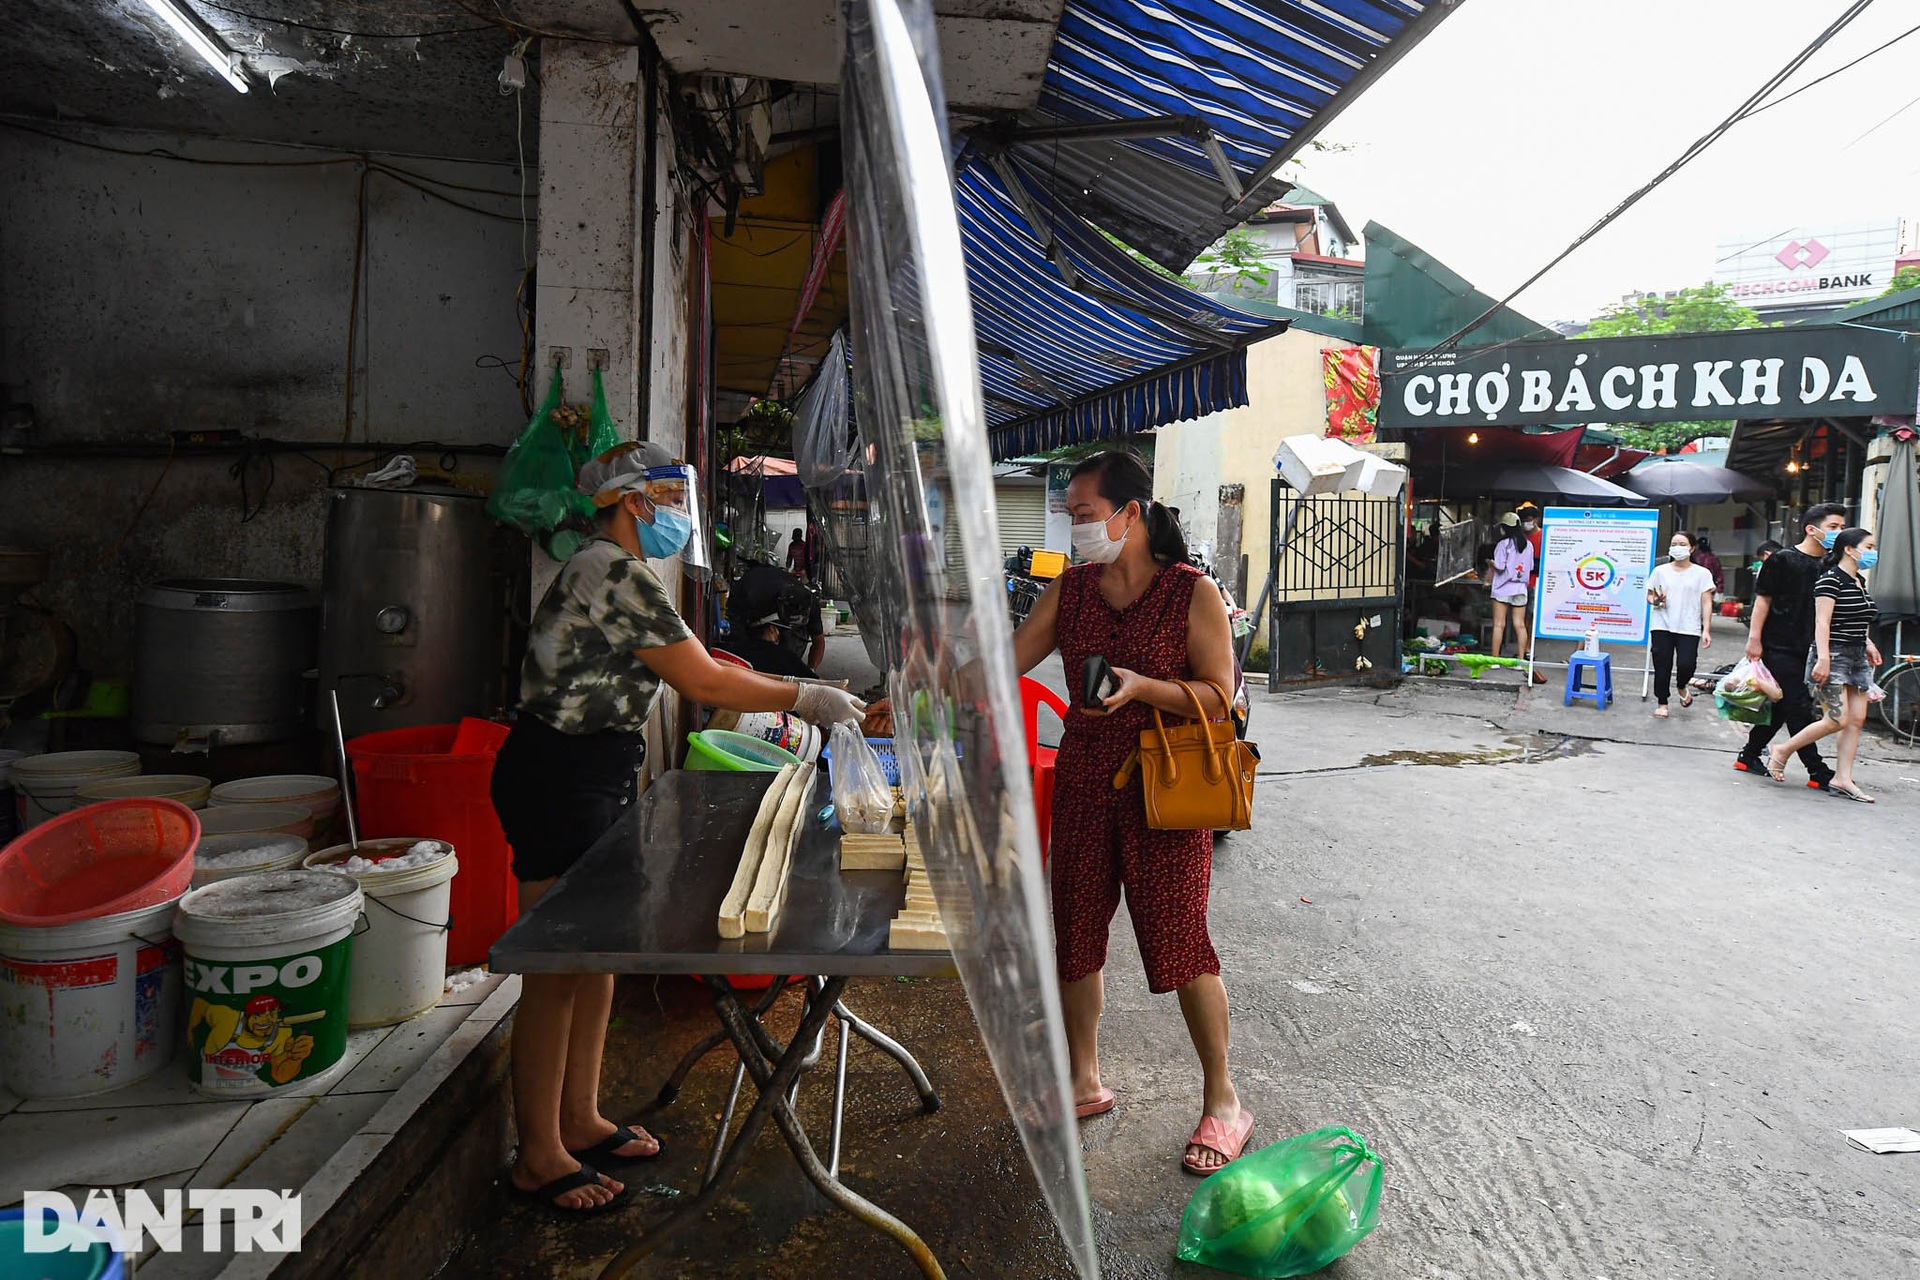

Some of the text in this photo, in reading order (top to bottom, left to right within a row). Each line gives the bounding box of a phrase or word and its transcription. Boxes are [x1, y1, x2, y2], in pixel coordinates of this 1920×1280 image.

[1732, 273, 1873, 297] TECHCOMBANK
[1403, 362, 1510, 421] CHỢ
[1518, 353, 1679, 413] BÁCH
[1585, 571, 1605, 581] 5K
[183, 955, 322, 995] EXPO
